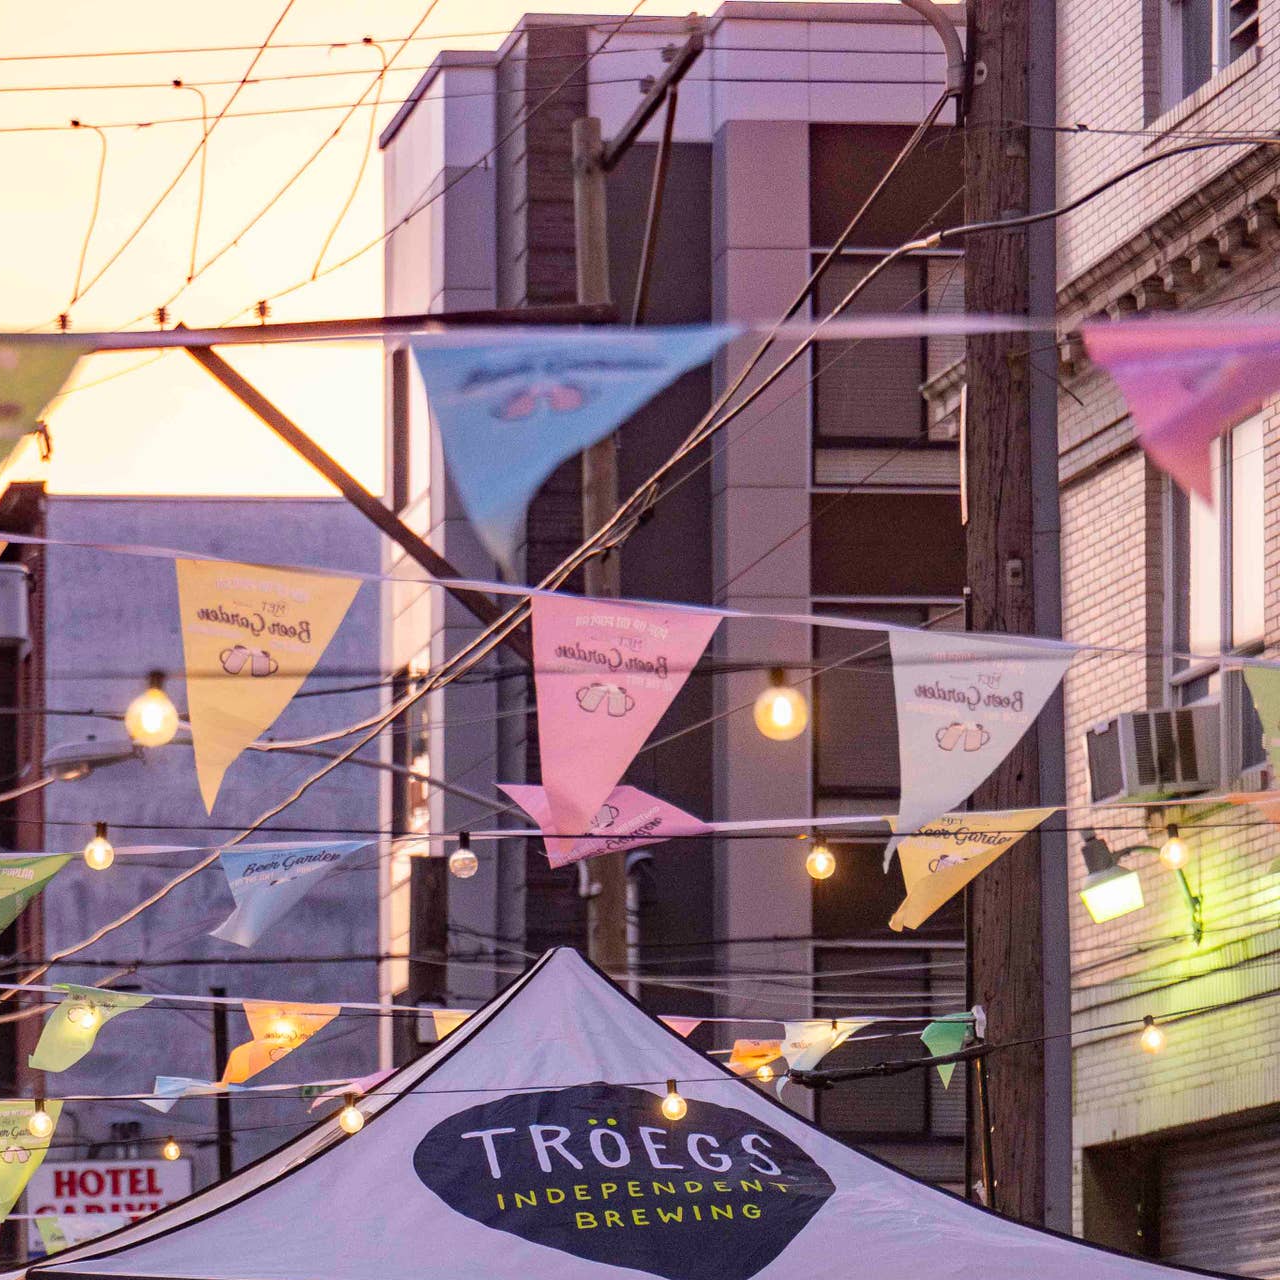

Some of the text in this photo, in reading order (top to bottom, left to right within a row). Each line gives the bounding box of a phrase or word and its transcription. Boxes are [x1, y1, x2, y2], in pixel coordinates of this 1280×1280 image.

[242, 849, 341, 877] Beer Garden
[461, 1117, 782, 1180] TRÖEGS
[54, 1167, 162, 1199] HOTEL
[496, 1179, 792, 1211] INDEPENDENT
[576, 1203, 763, 1230] BREWING
